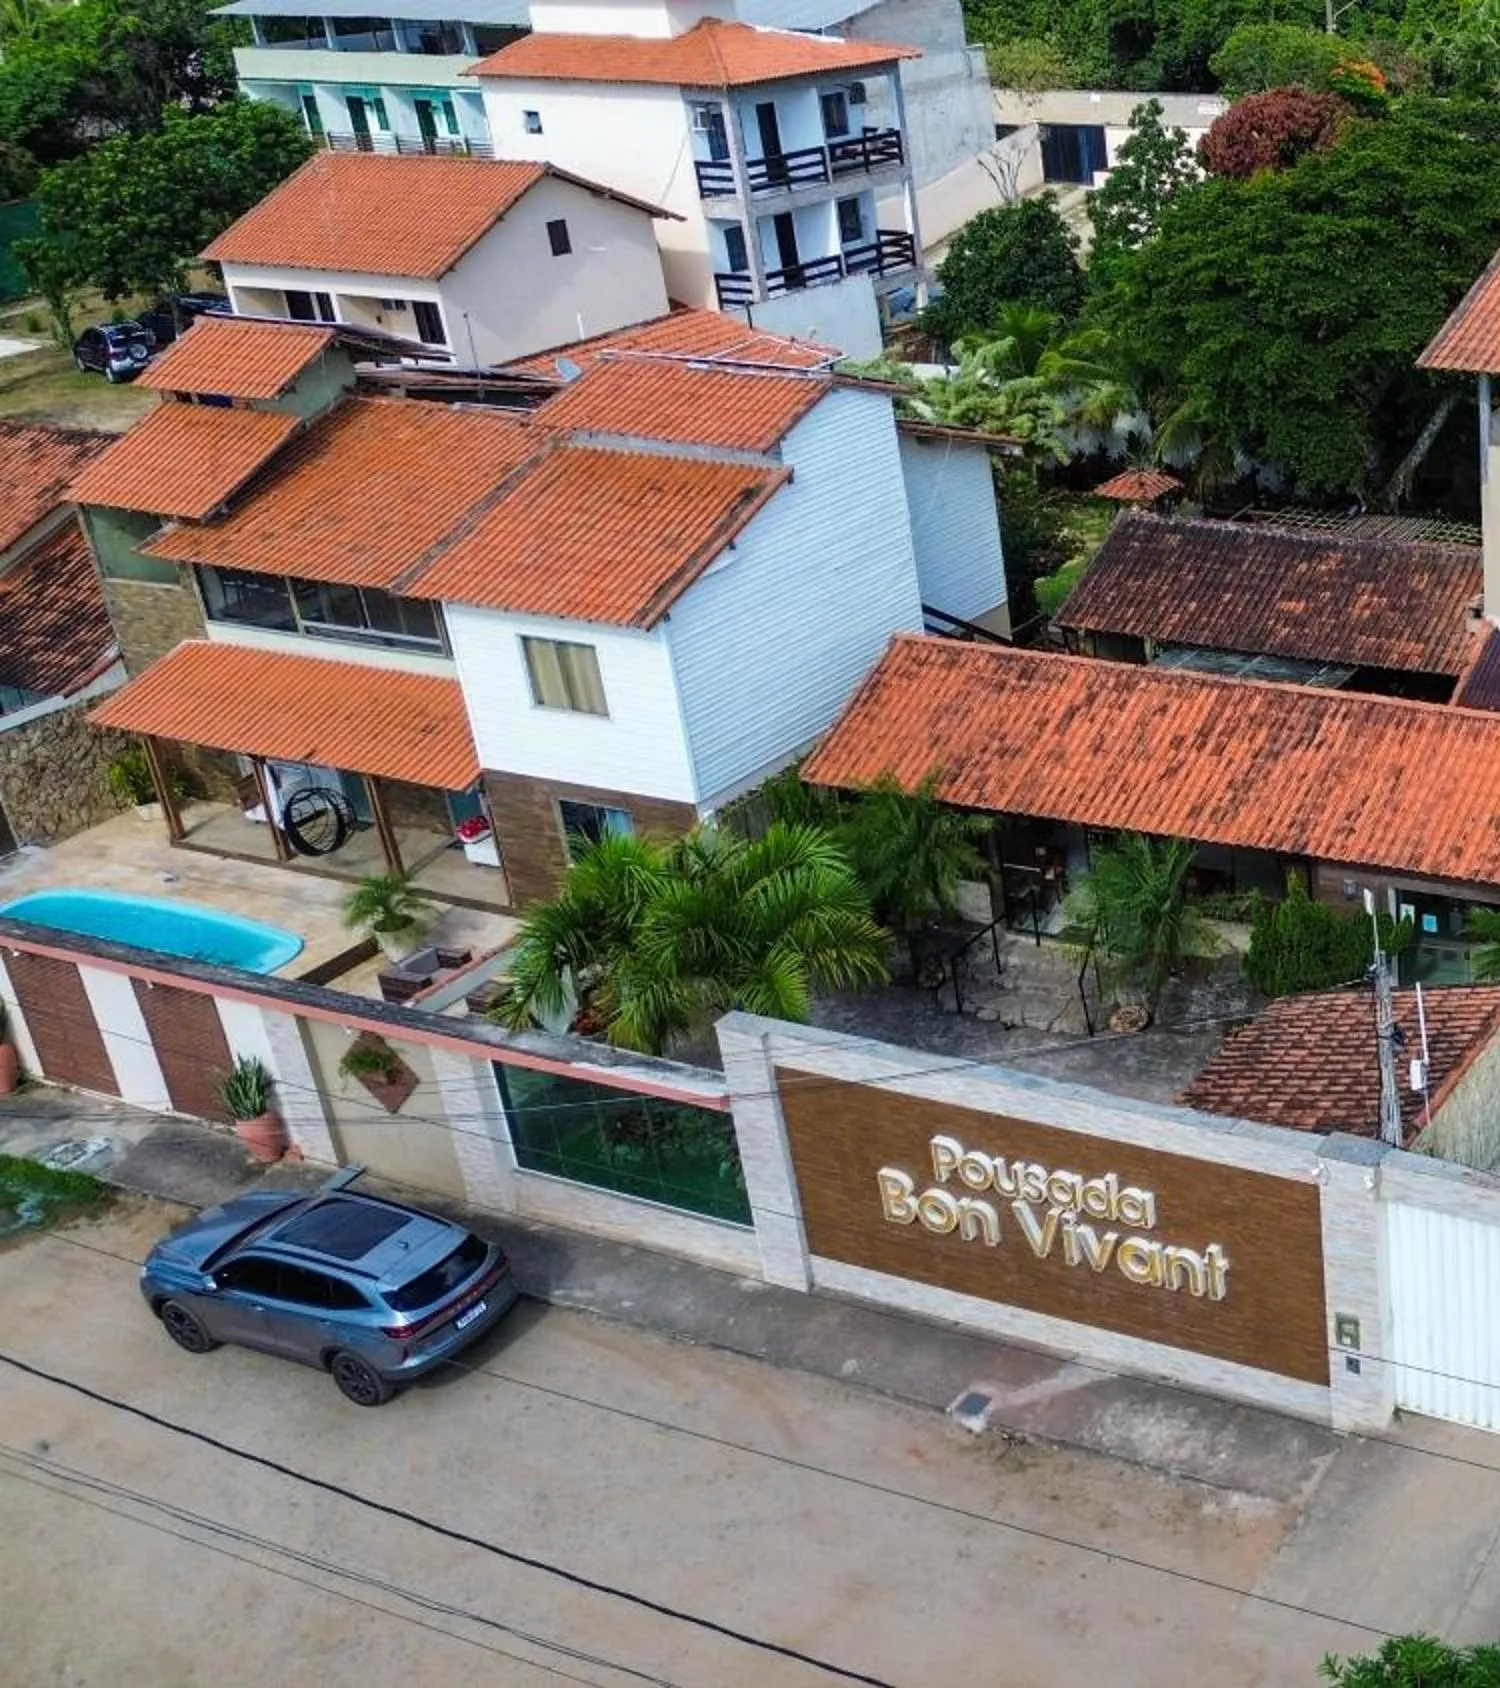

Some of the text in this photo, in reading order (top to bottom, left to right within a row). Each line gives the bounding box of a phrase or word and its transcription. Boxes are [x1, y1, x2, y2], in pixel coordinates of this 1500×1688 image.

[878, 1167, 1229, 1300] Bon Vivant
[930, 1135, 1155, 1228] Pousada
